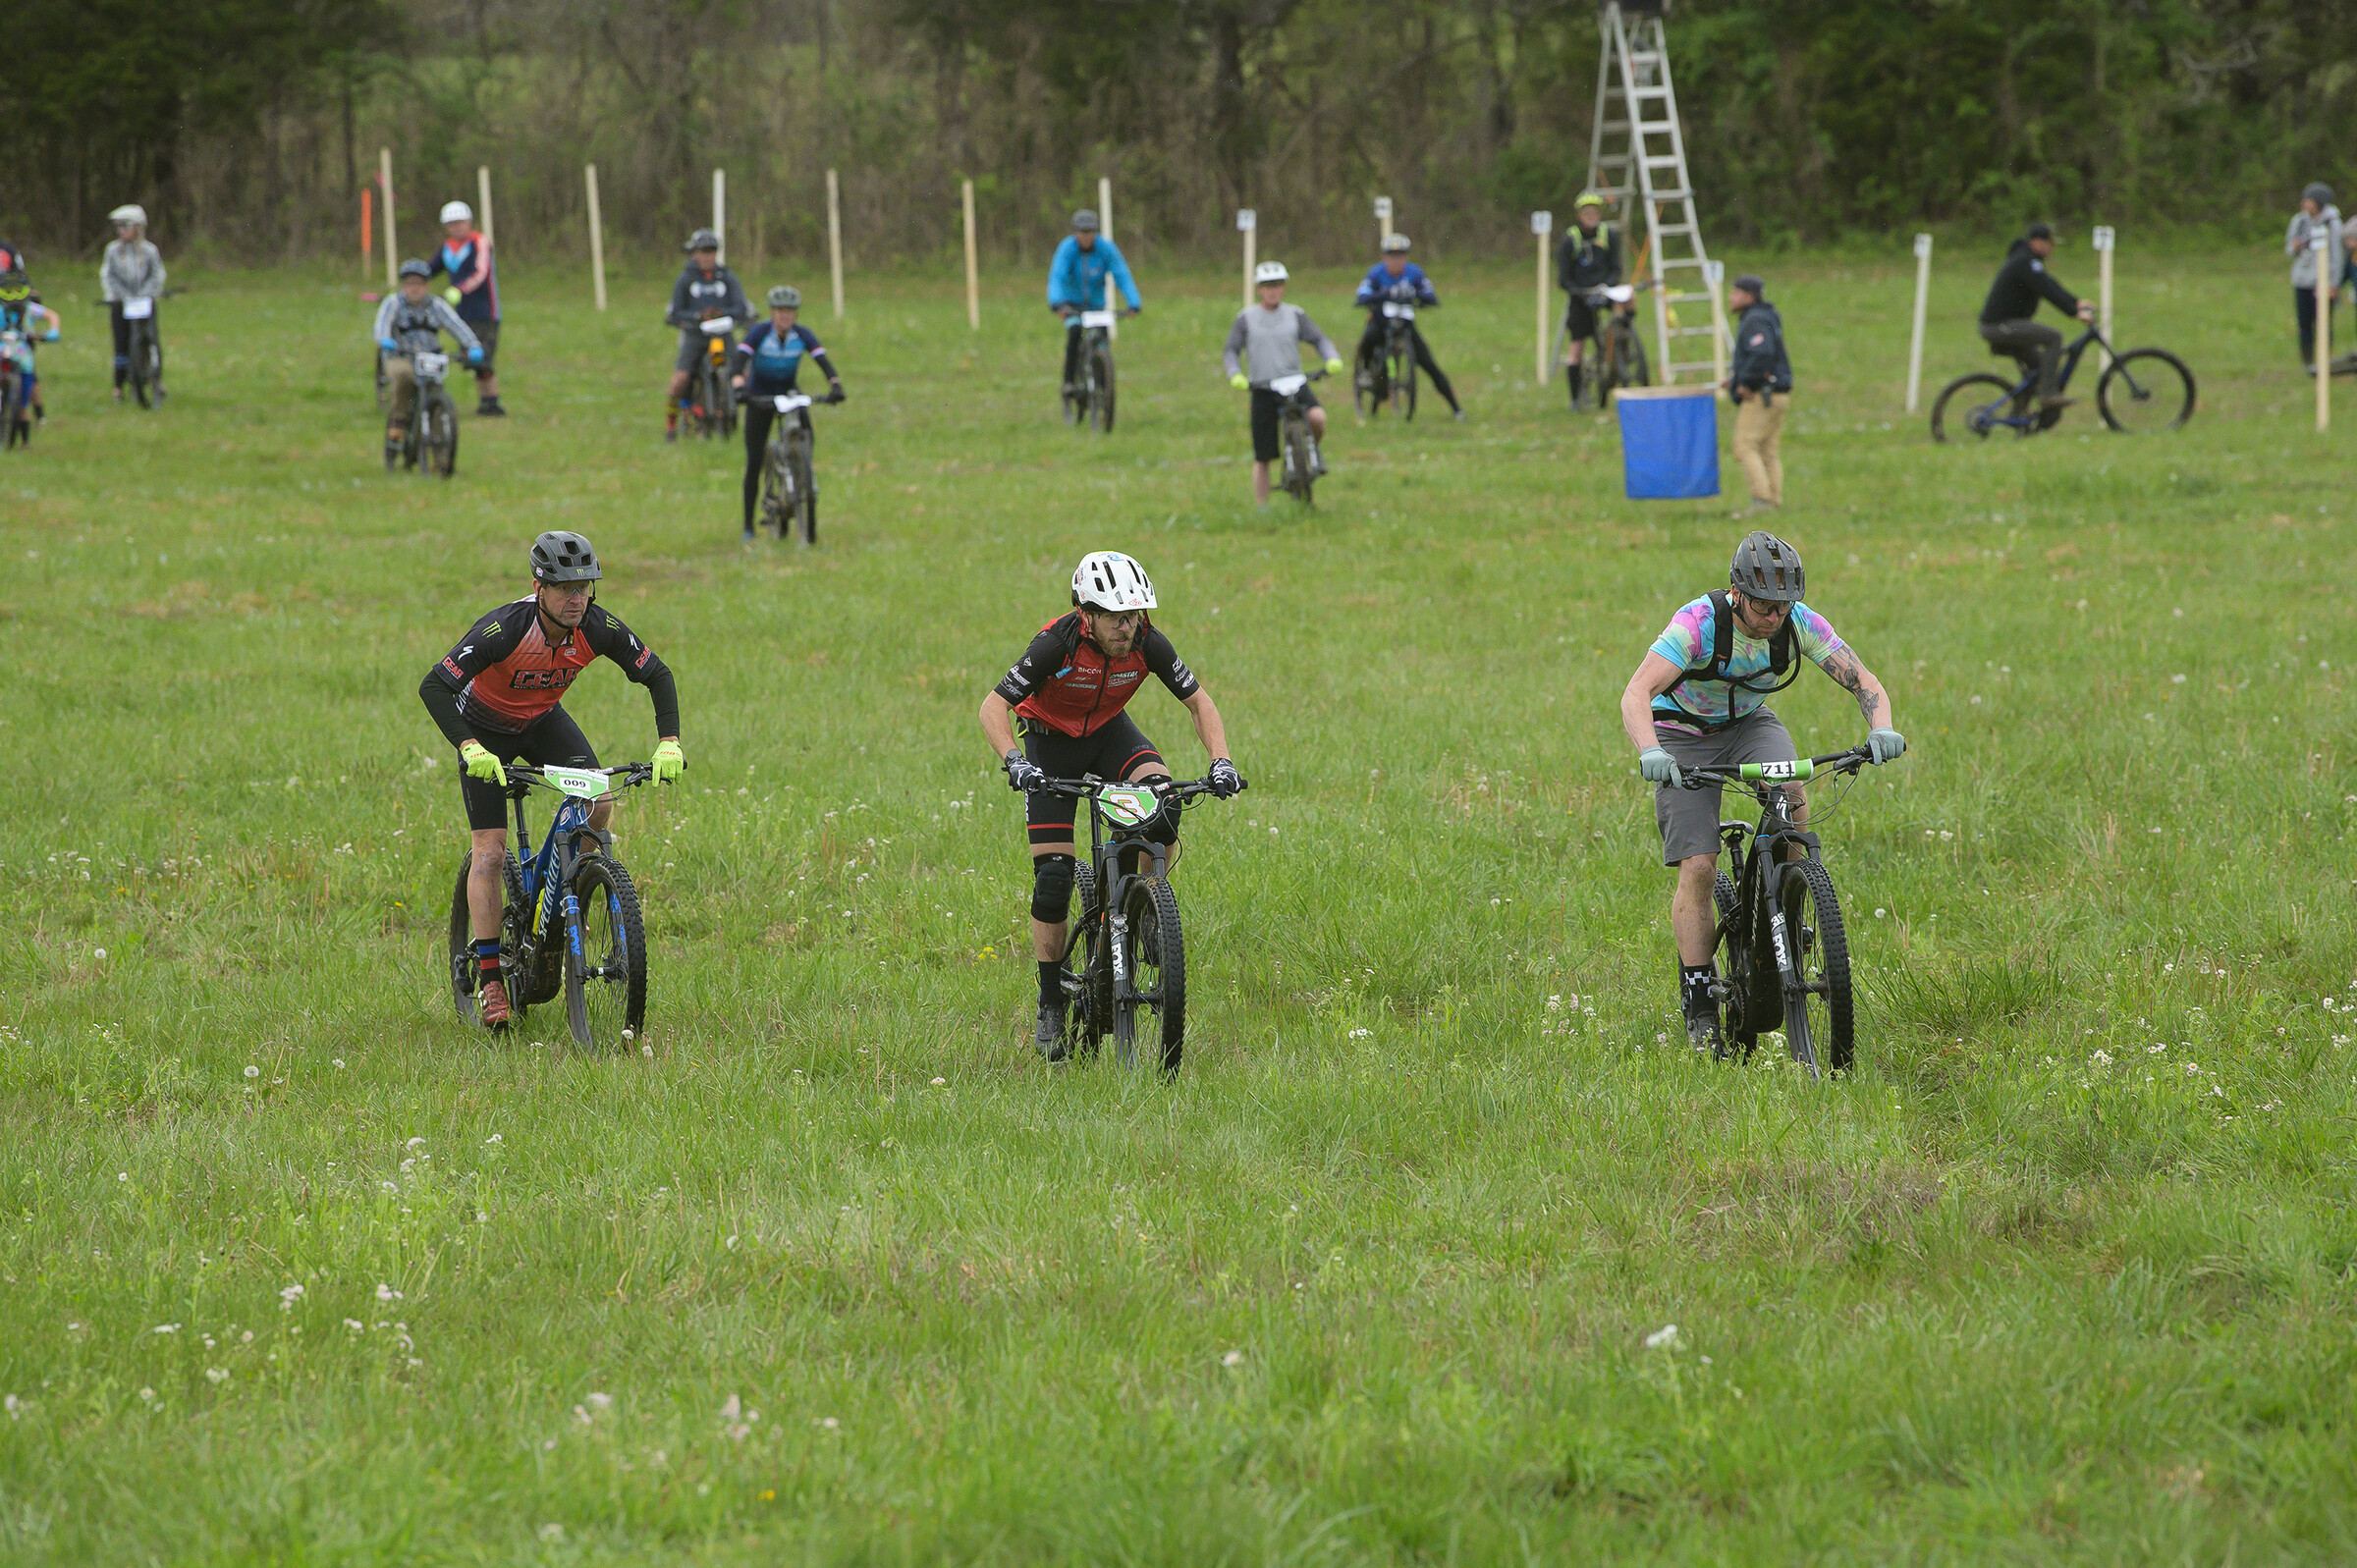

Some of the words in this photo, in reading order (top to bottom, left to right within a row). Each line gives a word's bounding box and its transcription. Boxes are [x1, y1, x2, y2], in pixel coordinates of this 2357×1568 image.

[443, 656, 464, 678] GEAR
[1762, 764, 1794, 775] 711
[564, 779, 586, 788] 009
[1109, 793, 1147, 819] 3
[569, 924, 581, 956] FOX
[1773, 932, 1787, 967] FOX
[1112, 943, 1124, 975] FOX
